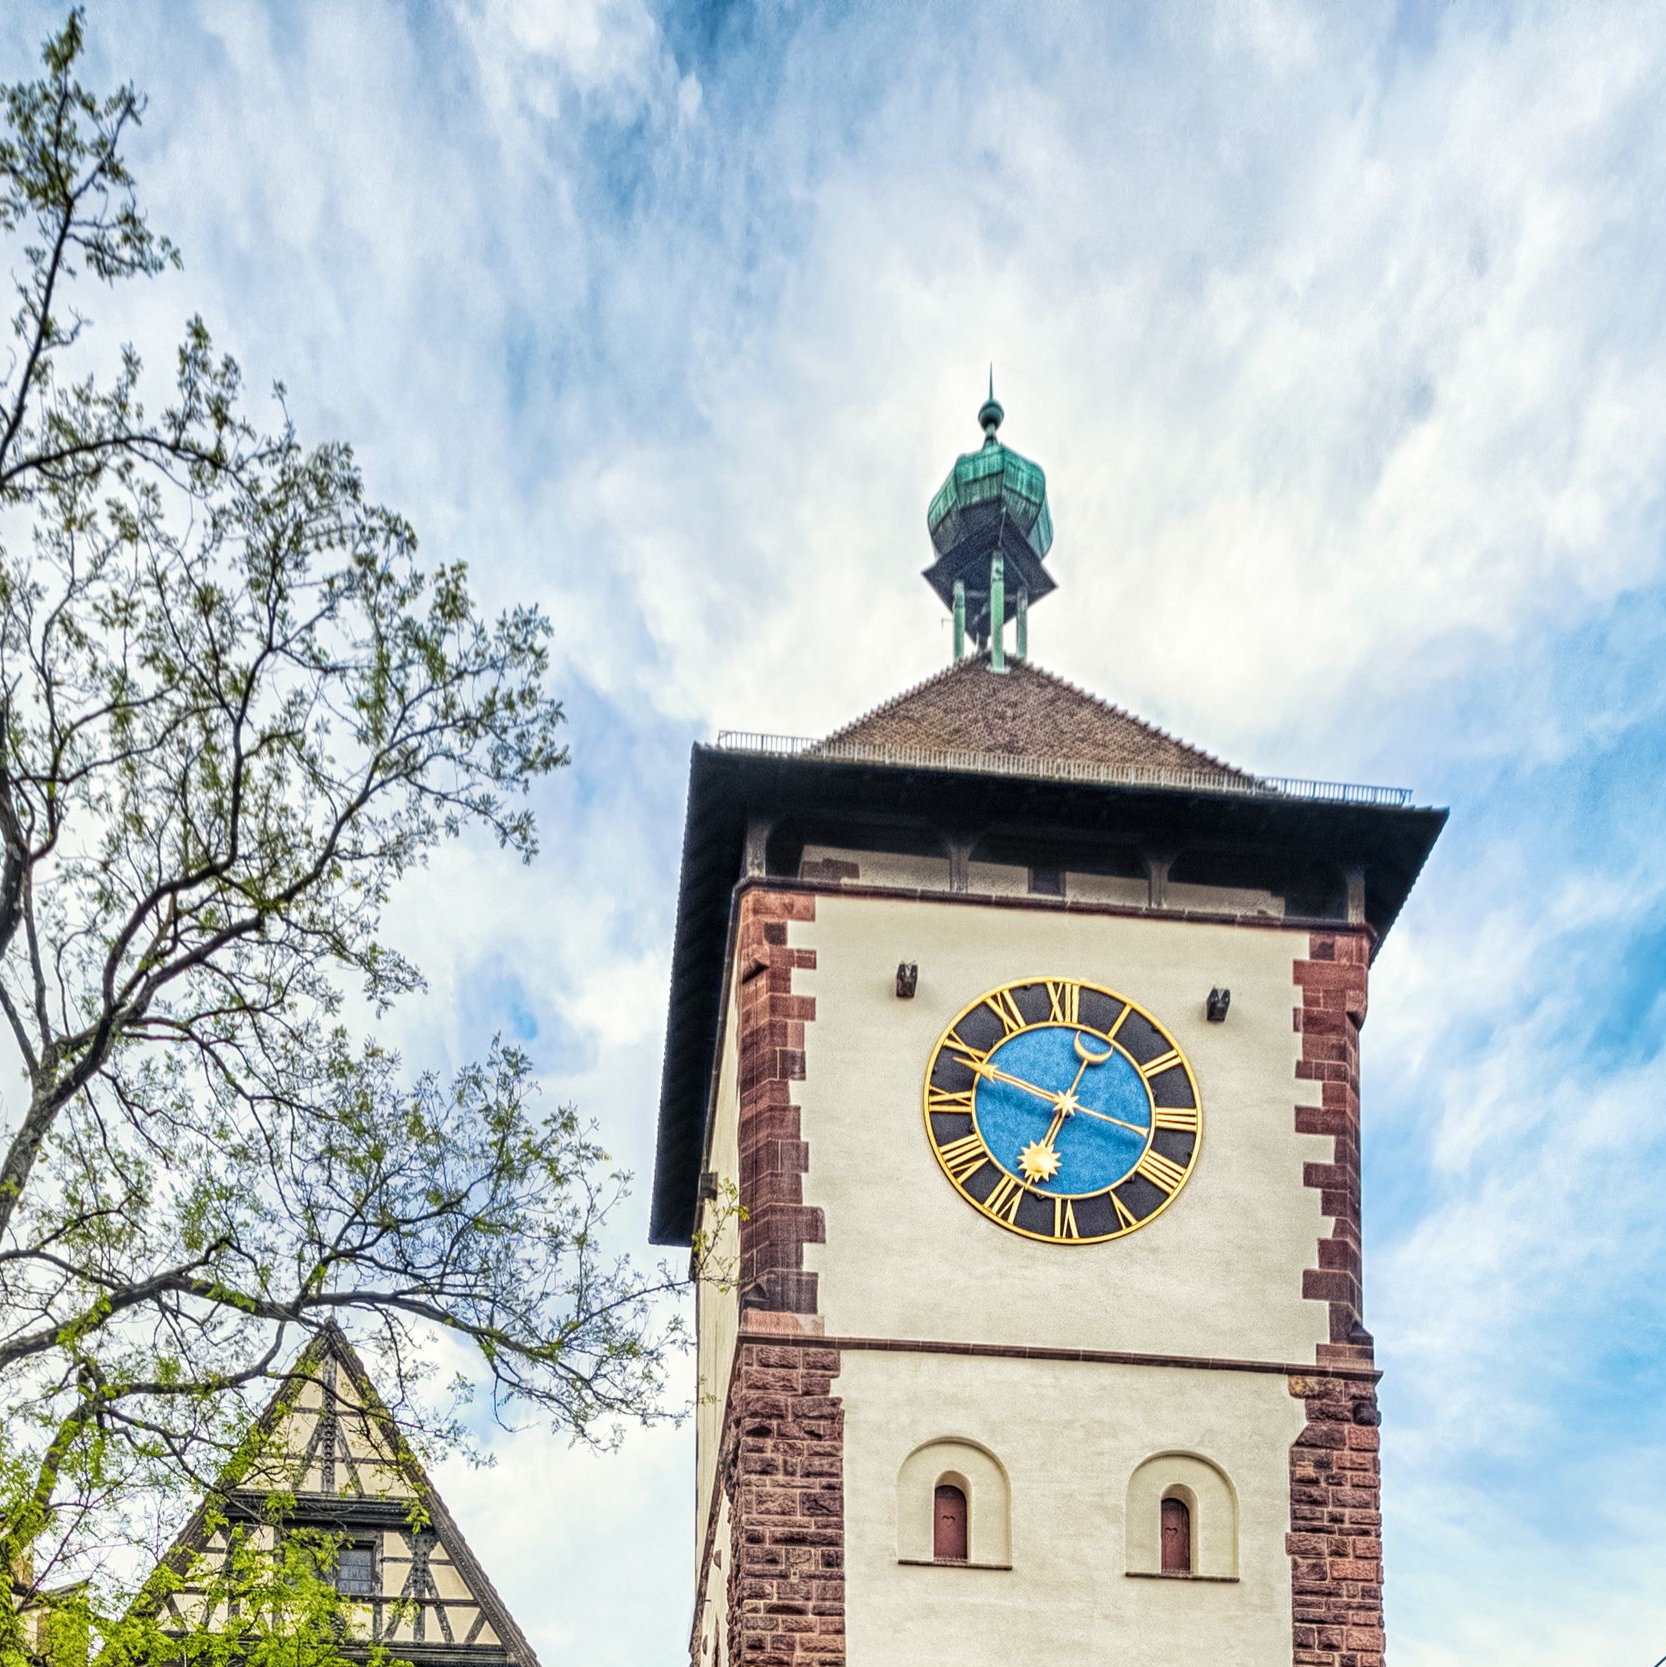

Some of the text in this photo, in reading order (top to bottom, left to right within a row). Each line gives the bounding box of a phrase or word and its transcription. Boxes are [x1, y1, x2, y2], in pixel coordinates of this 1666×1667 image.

[985, 989, 1026, 1035] XI
[1046, 981, 1080, 1024] XII
[1108, 1003, 1133, 1038] I
[942, 1029, 988, 1064] X
[1140, 1048, 1183, 1078] II
[929, 1084, 973, 1112] IX
[1155, 1106, 1198, 1132] III
[938, 1132, 989, 1185] VIII
[983, 1174, 1025, 1225] VII
[1055, 1196, 1080, 1239] VI
[1109, 1191, 1139, 1230] V
